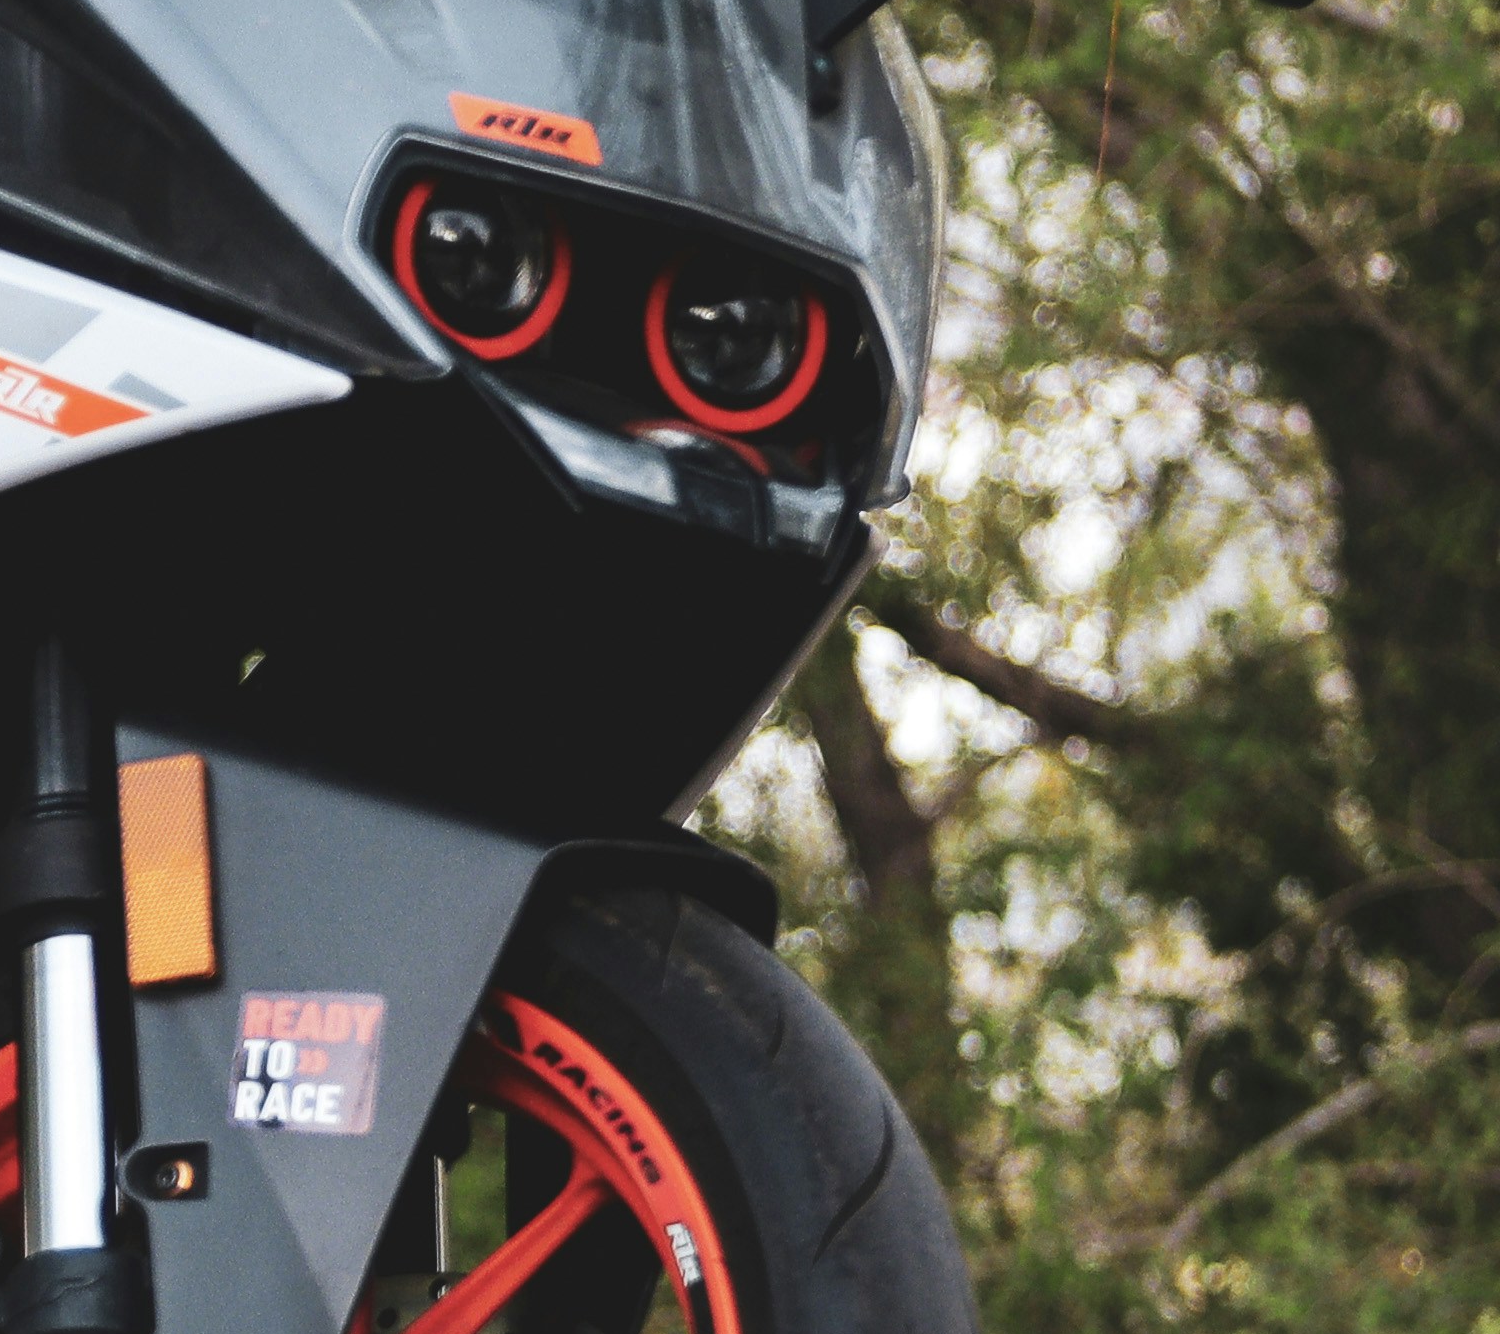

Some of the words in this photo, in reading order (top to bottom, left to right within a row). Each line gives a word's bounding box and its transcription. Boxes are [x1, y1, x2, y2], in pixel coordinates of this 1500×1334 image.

[242, 998, 384, 1045] READY
[242, 1038, 296, 1080] TO
[233, 1080, 344, 1124] RACE
